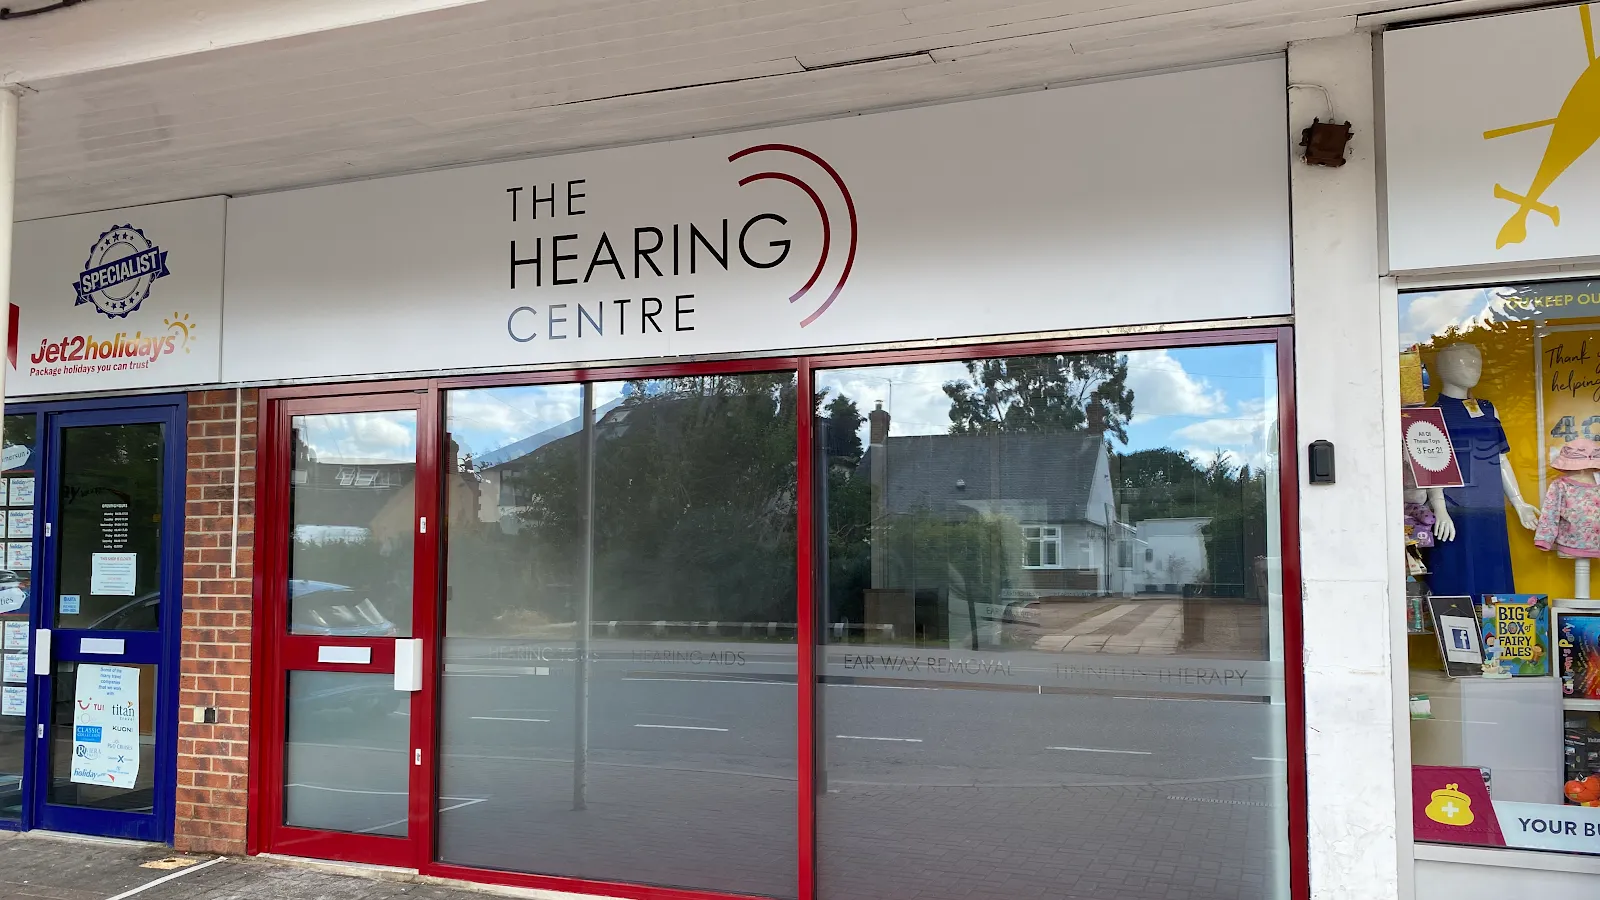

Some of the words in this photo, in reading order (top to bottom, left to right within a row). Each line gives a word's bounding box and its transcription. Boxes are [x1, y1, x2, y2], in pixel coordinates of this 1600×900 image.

[506, 178, 586, 222] THE
[510, 213, 791, 289] HEARING
[82, 250, 158, 294] SPECIALIST
[1534, 294, 1573, 307] KEEP
[507, 294, 695, 343] CENTRE
[31, 331, 176, 364] Jet2holidays
[1545, 340, 1590, 369] Thank
[30, 366, 62, 377] Package
[63, 363, 95, 374] holidays
[97, 364, 112, 374] you
[113, 362, 127, 371] can
[129, 360, 149, 370] trust
[1499, 606, 1525, 620] BIG
[1499, 621, 1525, 635] BOX
[1524, 623, 1534, 632] of
[1499, 636, 1532, 646] FAIRY
[632, 649, 703, 665] HEARING
[708, 651, 746, 666] AIDS
[844, 654, 876, 671] EAR
[880, 655, 921, 672] WAX
[927, 657, 1017, 677] REMOVAL
[1154, 666, 1249, 687] THERAPY
[112, 704, 135, 717] titan
[77, 726, 101, 734] CLASSIC
[73, 768, 98, 780] holiday
[1518, 817, 1578, 836] YOUR
[1584, 822, 1600, 837] B
